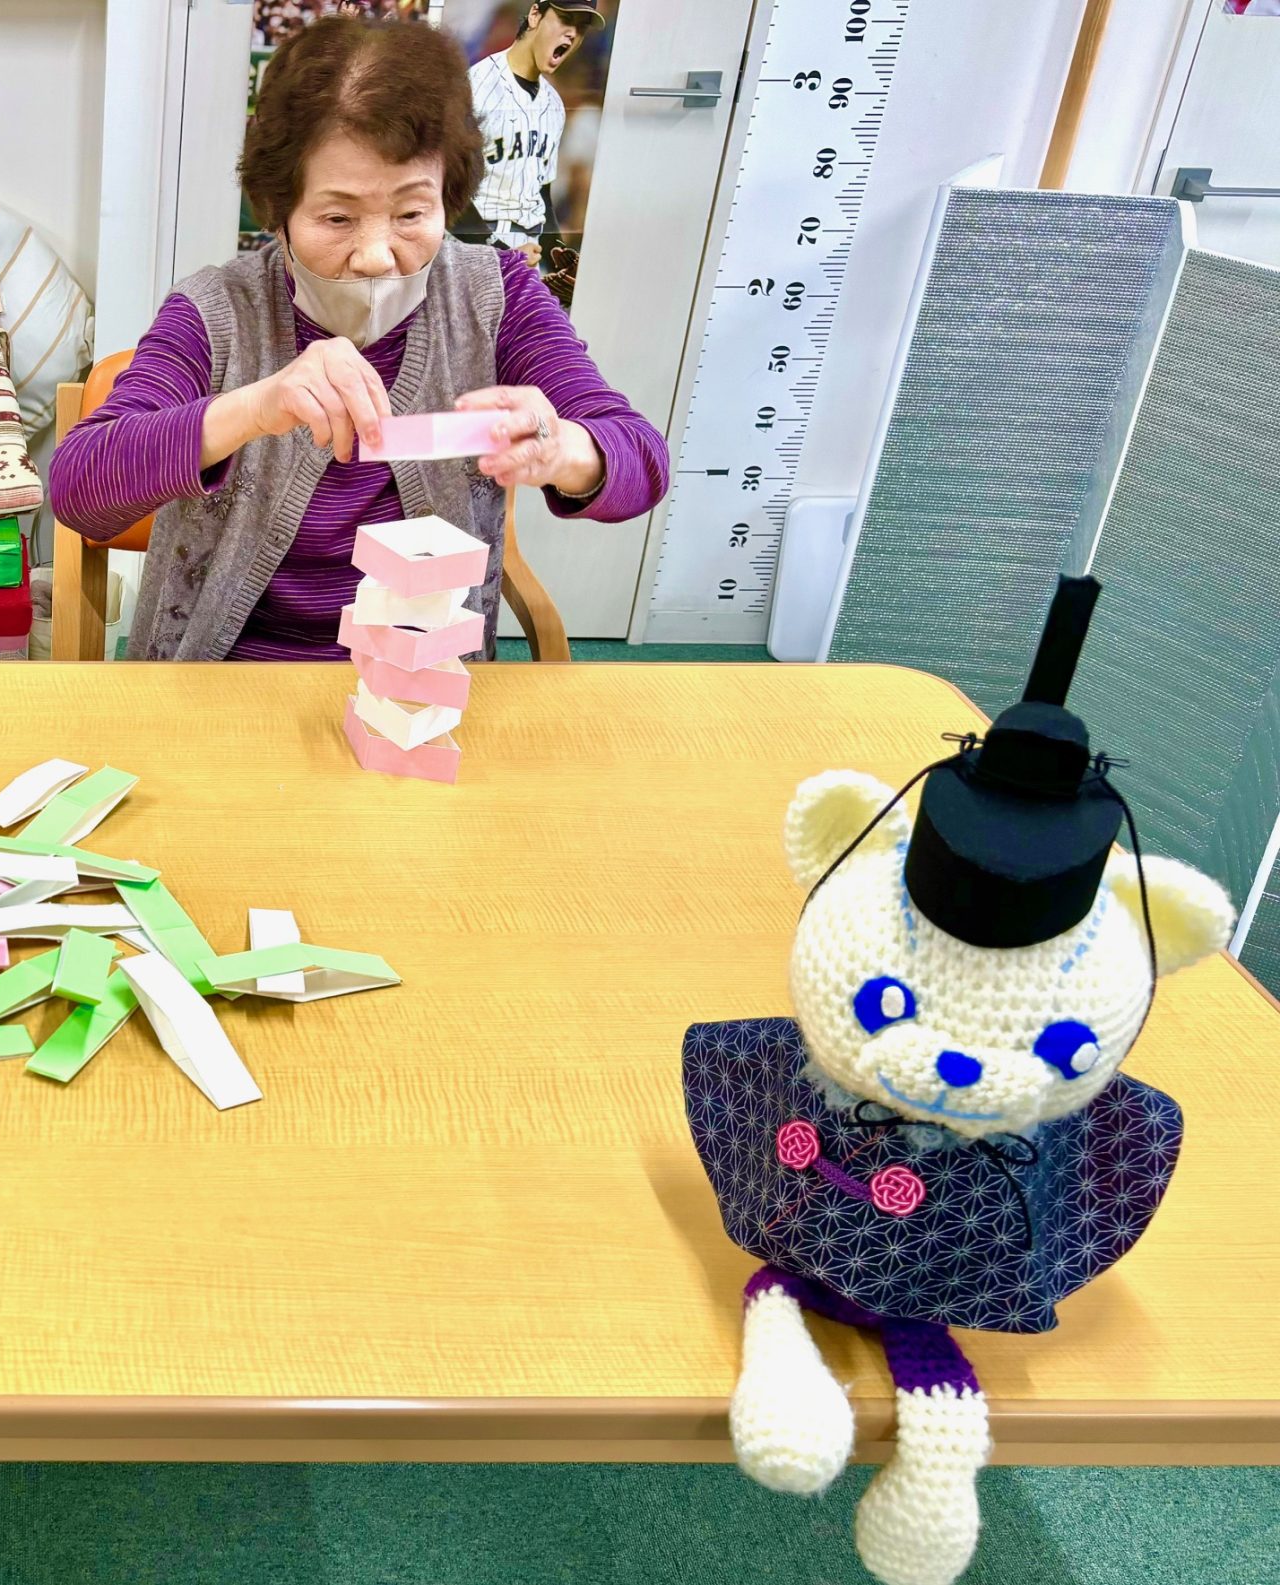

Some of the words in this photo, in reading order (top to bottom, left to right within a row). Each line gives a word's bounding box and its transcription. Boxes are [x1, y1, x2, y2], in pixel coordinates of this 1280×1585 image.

[845, 0, 871, 42] 100
[793, 70, 821, 91] 3
[829, 78, 853, 109] 90
[486, 129, 549, 166] JAPA
[813, 148, 836, 179] 80
[797, 217, 820, 245] 70
[748, 278, 775, 296] 2
[783, 282, 805, 310] 60
[768, 346, 790, 372] 50
[755, 407, 776, 433] 40
[706, 468, 729, 477] 1
[742, 466, 762, 491] 30
[729, 523, 750, 547] 20
[717, 579, 737, 600] 10
